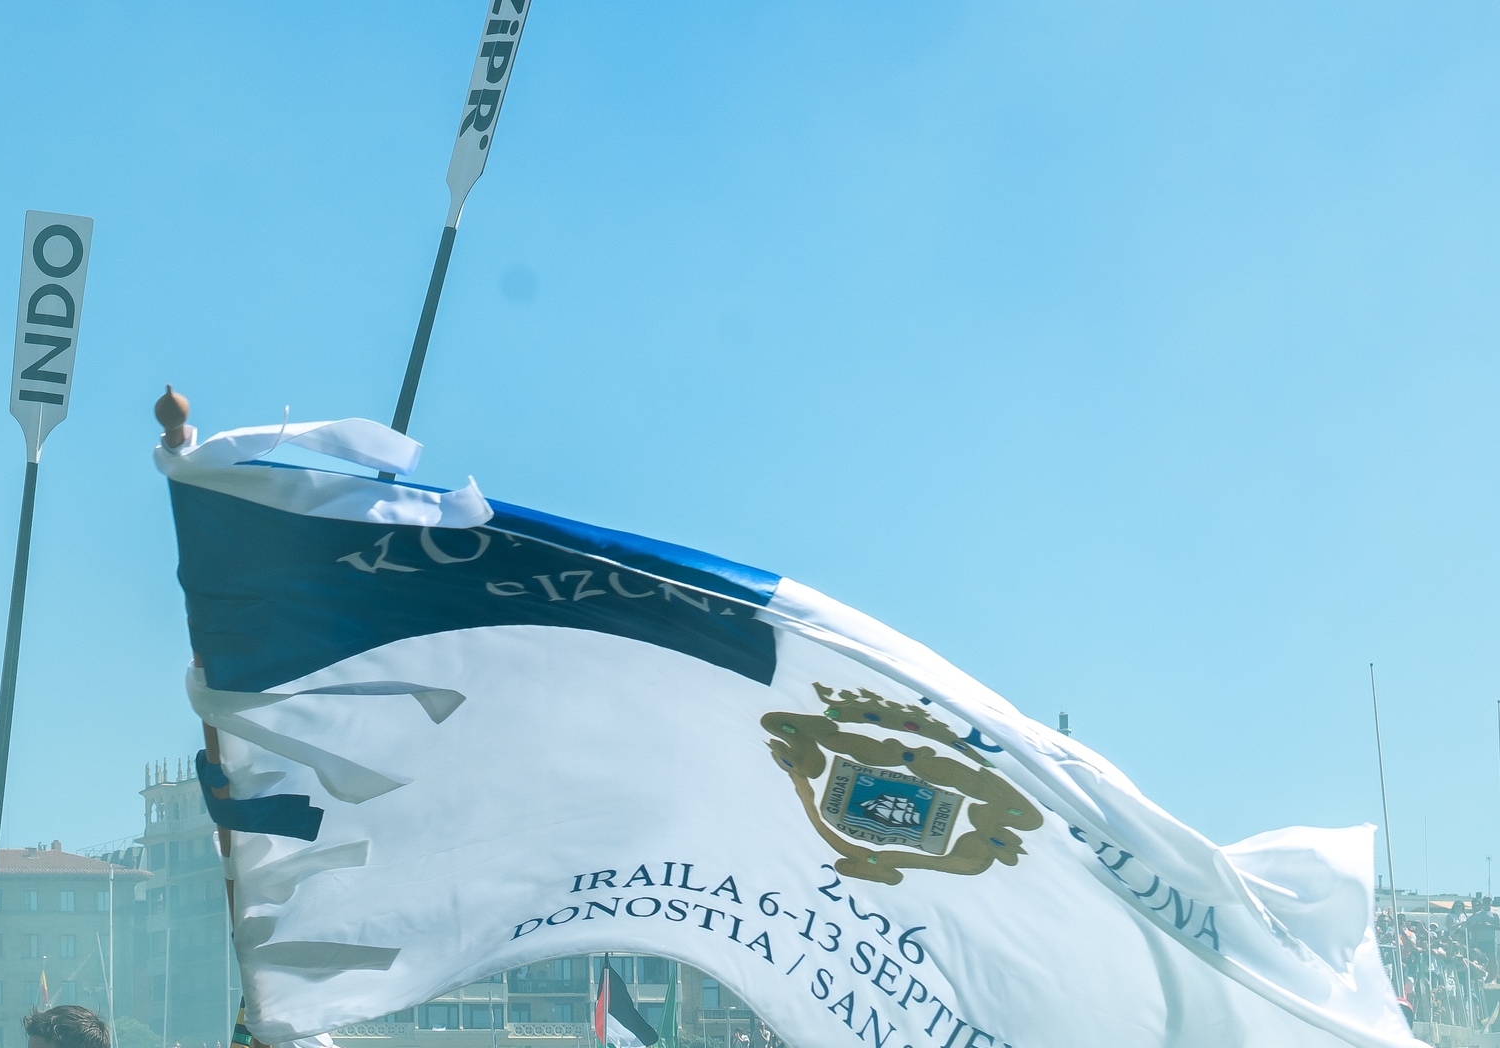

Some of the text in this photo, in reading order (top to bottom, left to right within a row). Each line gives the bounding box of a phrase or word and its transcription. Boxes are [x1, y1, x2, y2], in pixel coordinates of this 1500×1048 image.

[19, 224, 84, 406] INDO
[842, 761, 874, 775] POR
[827, 775, 850, 815] GANADAS
[836, 823, 907, 844] LEALTAD
[930, 801, 953, 838] NOBLEZA
[569, 861, 743, 905] IRAILA
[759, 891, 843, 953] 6-13
[511, 896, 776, 966] DONOSTIA
